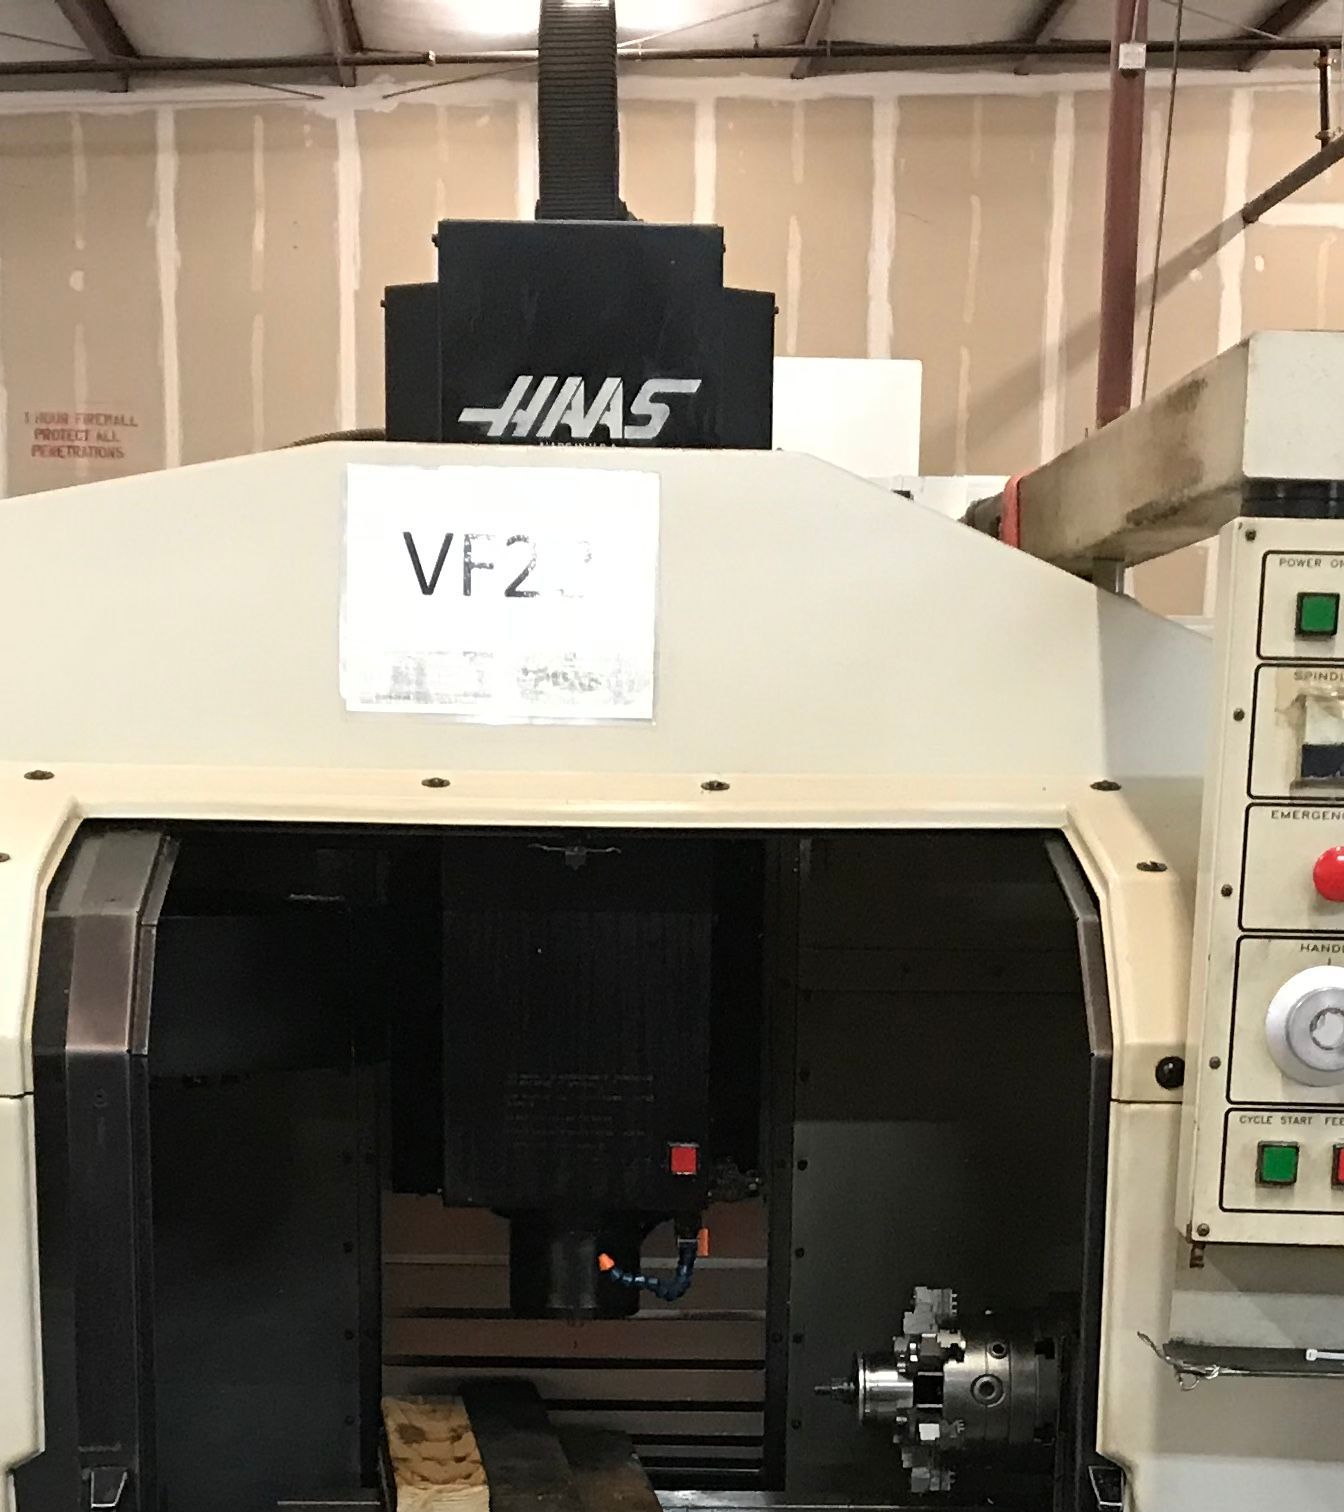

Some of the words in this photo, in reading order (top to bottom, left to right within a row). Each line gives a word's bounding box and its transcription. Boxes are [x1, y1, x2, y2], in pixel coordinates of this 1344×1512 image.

[457, 375, 702, 439] HAAS
[35, 412, 68, 425] HOUR
[75, 413, 138, 427] FIREWALL
[34, 428, 89, 441] PROTECT
[96, 430, 121, 442] ALL
[31, 445, 125, 459] PENETRATIONS
[1279, 557, 1322, 568] POWER
[1239, 1115, 1273, 1125] CYCLE
[1280, 1116, 1313, 1125] START
